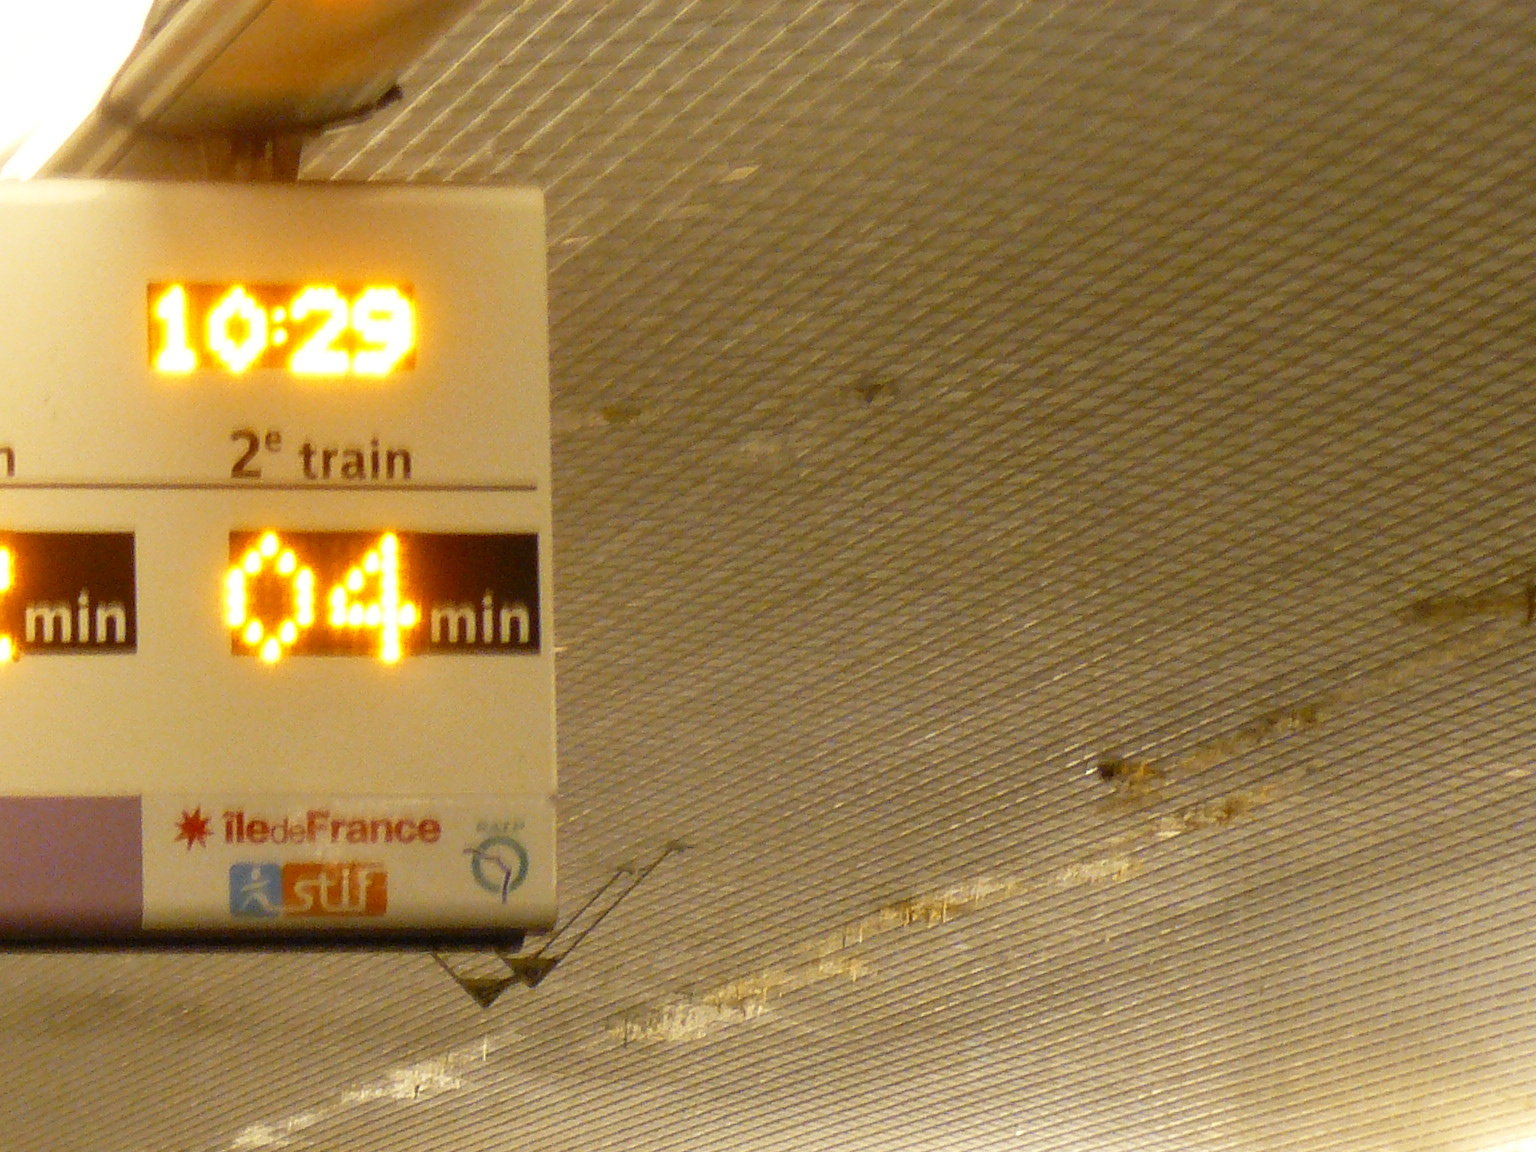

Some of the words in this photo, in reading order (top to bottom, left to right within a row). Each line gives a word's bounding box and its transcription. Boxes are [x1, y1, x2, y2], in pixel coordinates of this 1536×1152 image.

[152, 286, 416, 374] 10:29
[300, 438, 412, 479] train
[25, 587, 128, 643] min
[225, 532, 420, 664] 04
[430, 588, 531, 644] min
